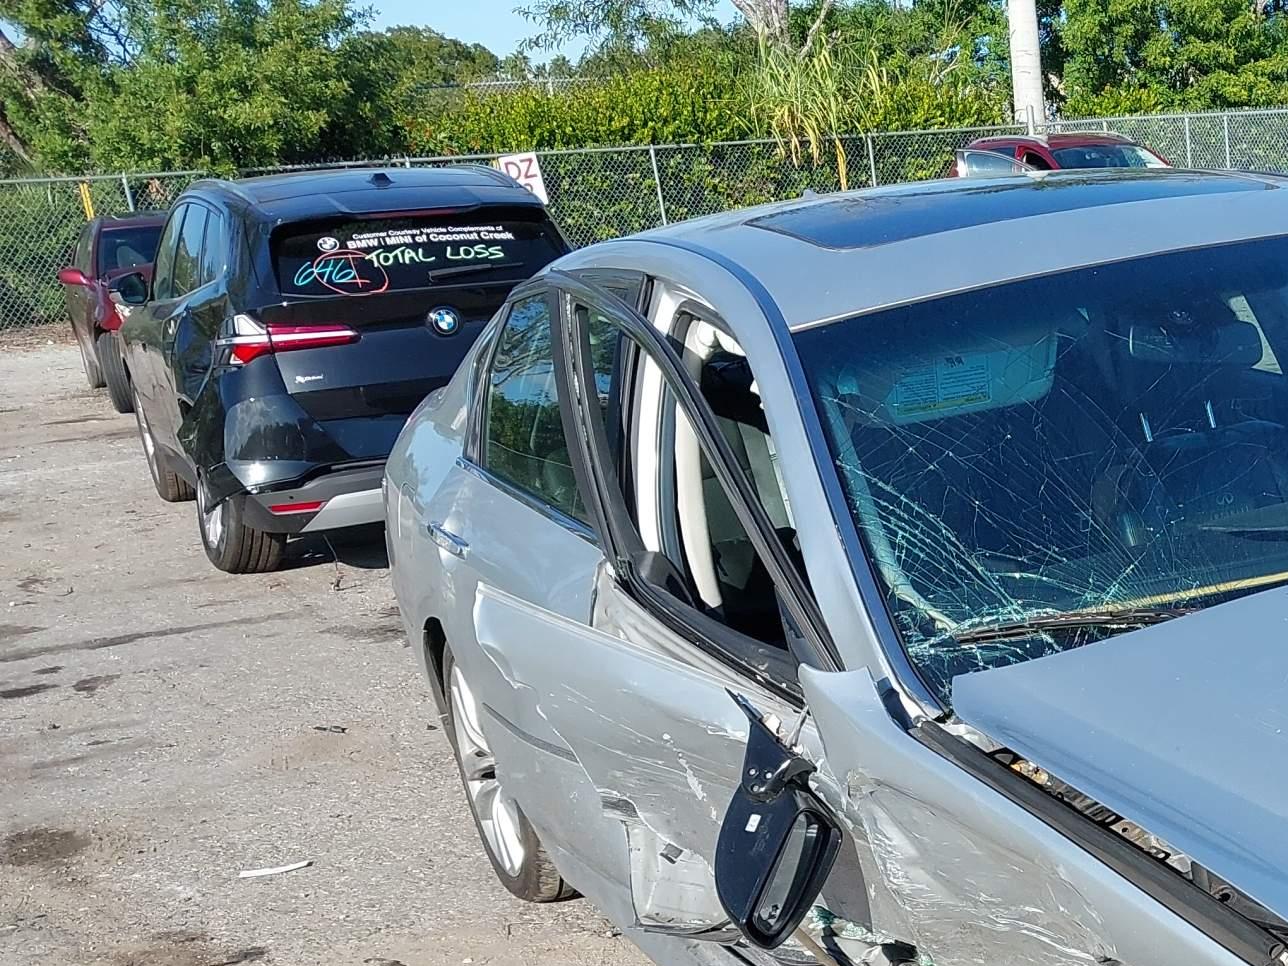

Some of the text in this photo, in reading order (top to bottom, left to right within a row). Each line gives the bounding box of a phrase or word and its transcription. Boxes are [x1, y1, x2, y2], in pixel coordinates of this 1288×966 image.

[346, 238, 378, 249] BMW
[385, 235, 413, 246] MINI
[415, 233, 428, 243] of
[429, 231, 479, 242] Coconut
[480, 231, 515, 240] Creek
[352, 231, 387, 240] Customer
[365, 244, 505, 268] TOTAL LOSS
